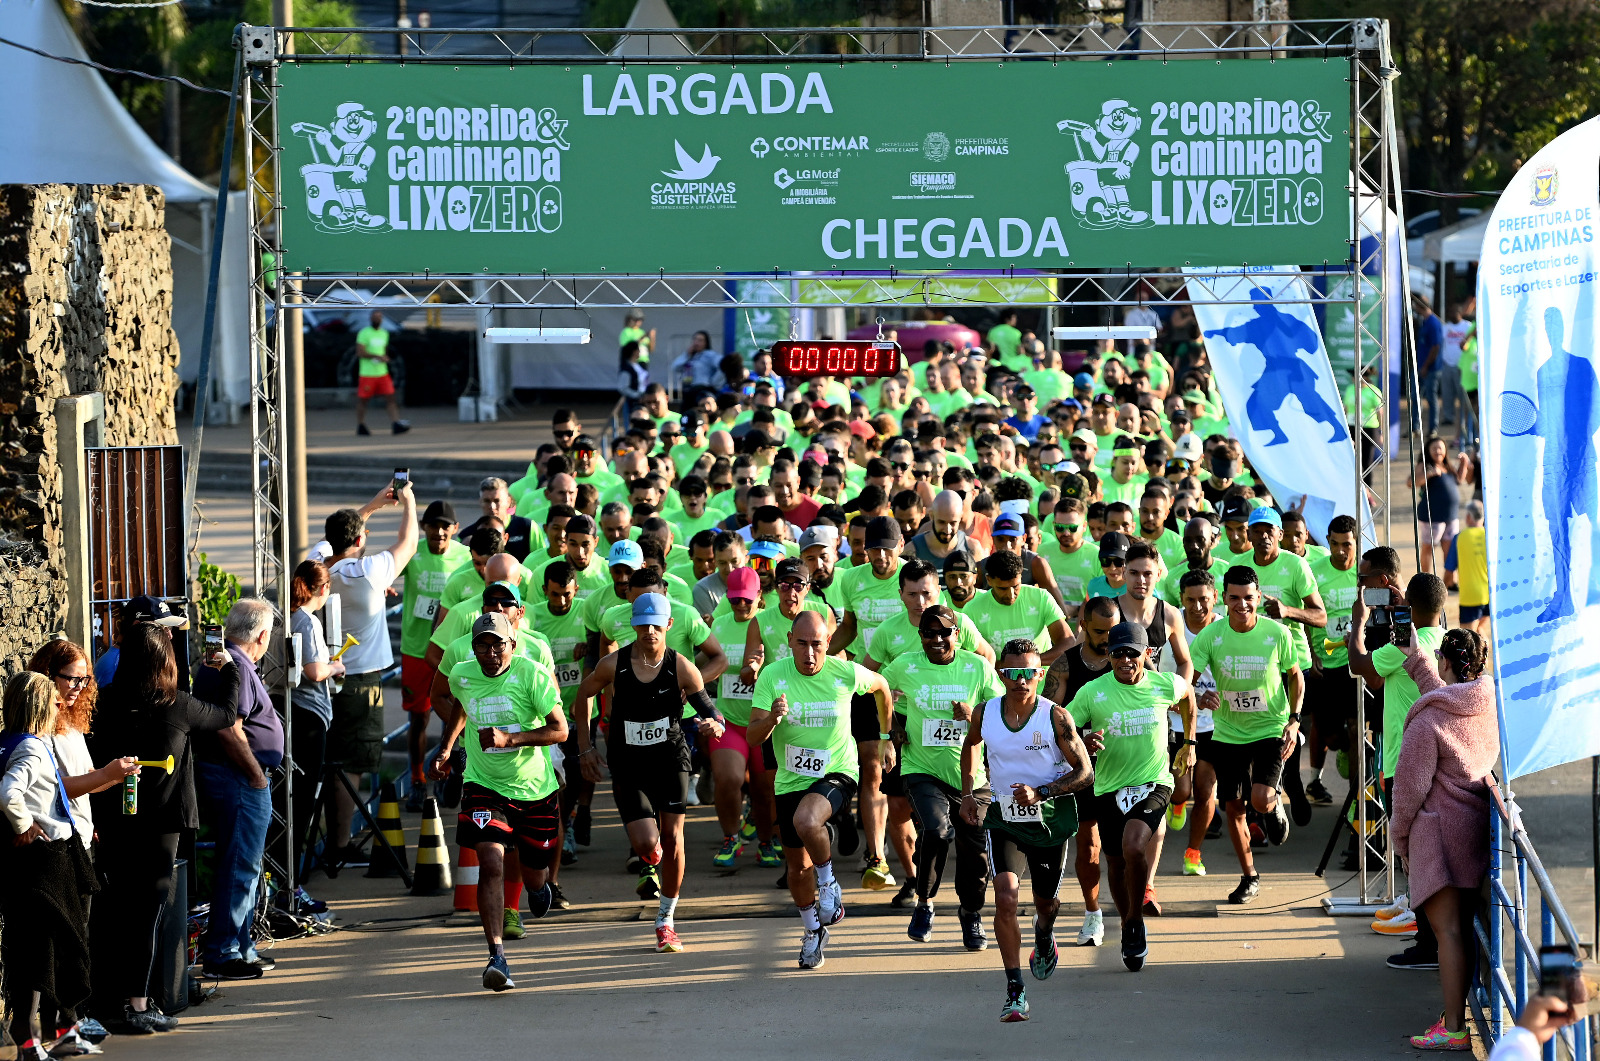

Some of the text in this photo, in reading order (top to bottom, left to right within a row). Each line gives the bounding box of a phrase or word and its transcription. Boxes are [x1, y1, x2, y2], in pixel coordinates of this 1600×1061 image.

[582, 72, 833, 116] LARGADA
[773, 135, 869, 151] CONTEMAR
[955, 145, 1009, 155] CAMPINAS
[796, 169, 811, 179] LG
[911, 174, 955, 185] SIEMACO
[650, 181, 736, 194] CAMPINAS
[790, 188, 794, 196] A
[651, 192, 737, 205] SUSTENTÁVEL
[805, 197, 814, 205] EM
[1499, 207, 1592, 232] PREFEITURA DE
[821, 216, 1069, 260] CHEGADA
[1499, 225, 1594, 255] CAMPINAS
[1500, 253, 1579, 276] Secretaria de
[1500, 271, 1599, 298] Esportes e Lazer
[614, 547, 631, 556] NYC
[556, 669, 578, 682] 109
[732, 682, 754, 694] 224
[1234, 696, 1260, 708] 157
[636, 727, 662, 741] 160
[933, 727, 960, 741] 425
[794, 755, 821, 772] 248
[1008, 803, 1037, 817] 186
